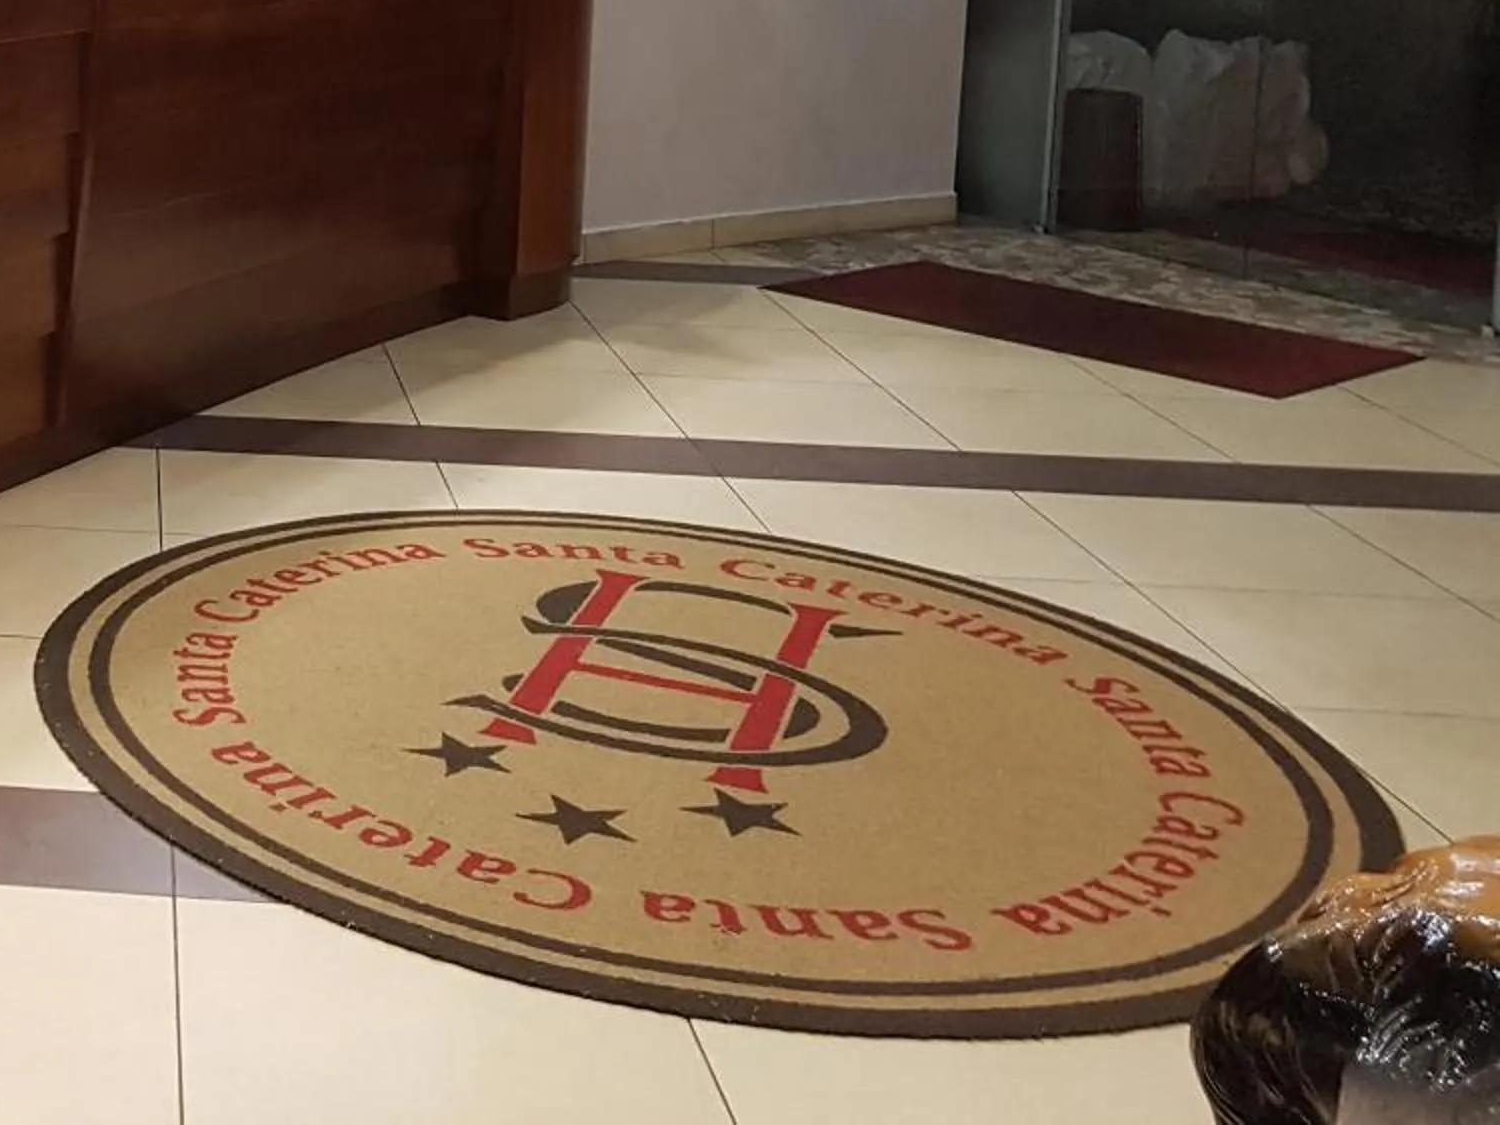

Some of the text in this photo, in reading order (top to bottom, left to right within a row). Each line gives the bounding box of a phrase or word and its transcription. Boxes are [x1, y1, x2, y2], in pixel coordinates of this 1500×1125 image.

[172, 541, 445, 728] Santa Caterina
[463, 537, 1070, 667] Santa Caterina
[210, 741, 974, 952] Santa Caterina
[991, 675, 1246, 937] Santa Caterina
